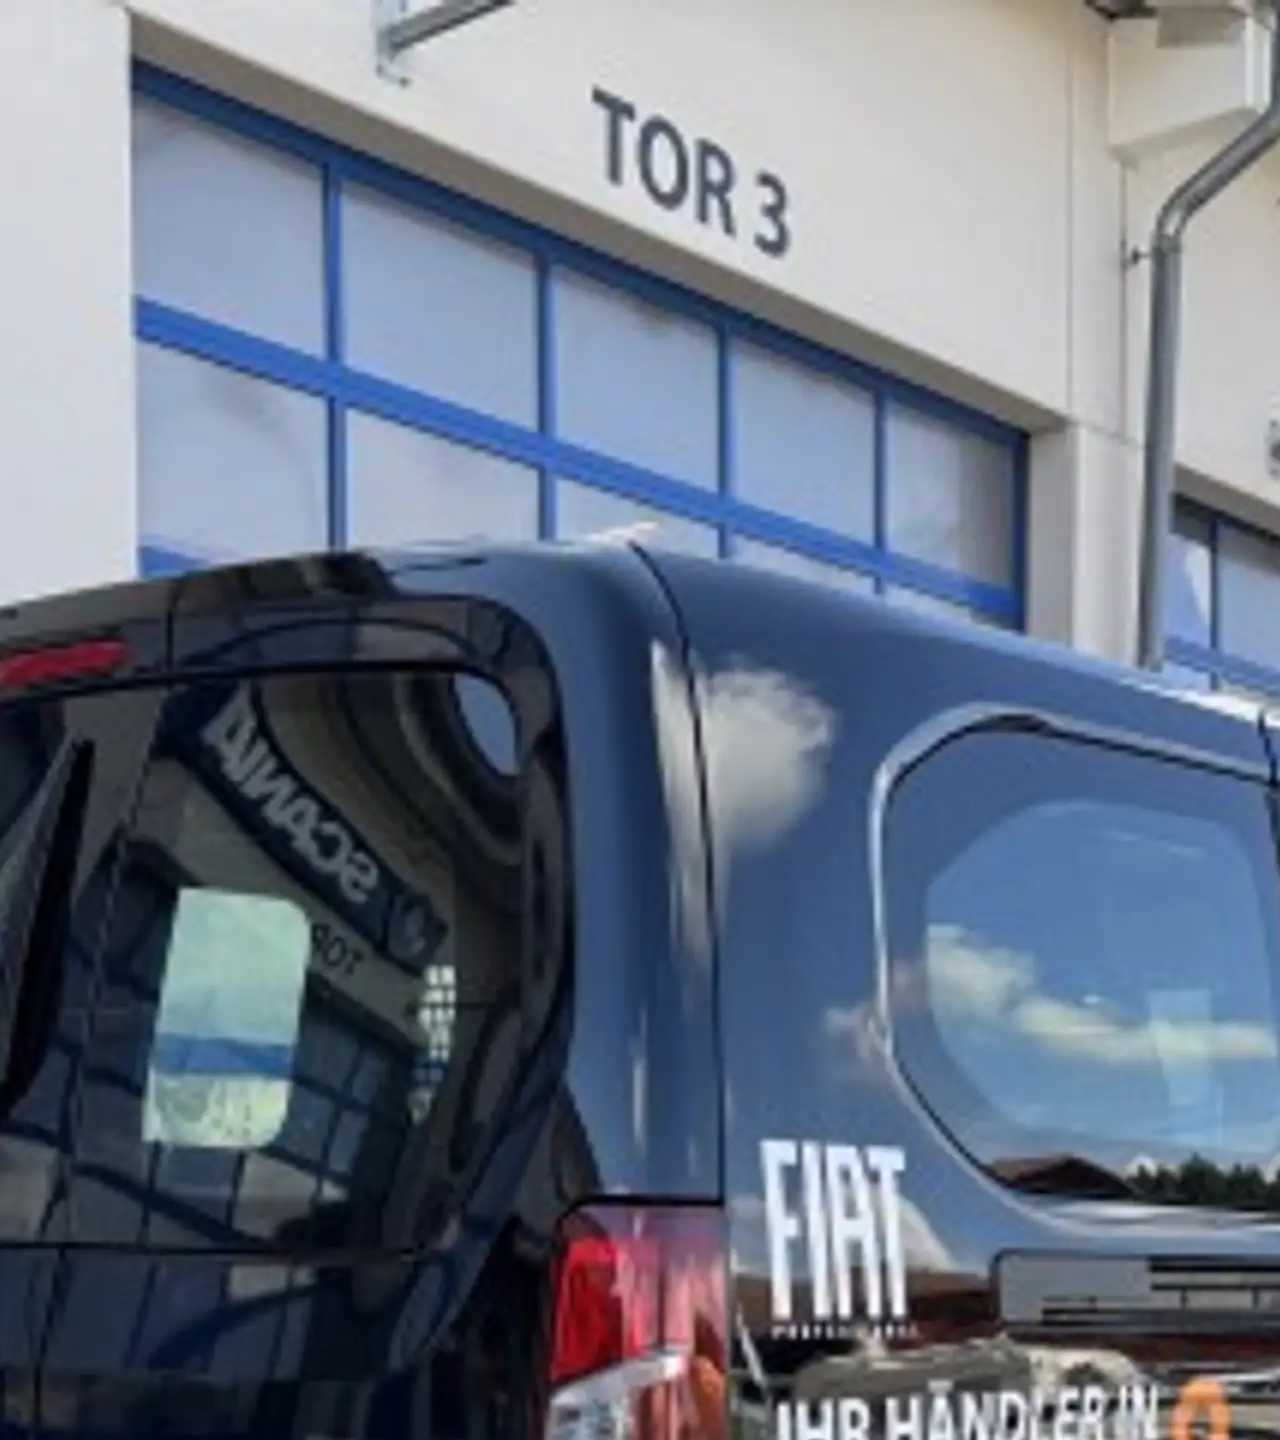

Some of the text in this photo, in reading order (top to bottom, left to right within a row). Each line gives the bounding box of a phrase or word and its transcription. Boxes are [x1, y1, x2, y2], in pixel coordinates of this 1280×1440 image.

[591, 84, 790, 258] TOR 3
[760, 1138, 906, 1321] FIAT
[1116, 1385, 1160, 1440] IN
